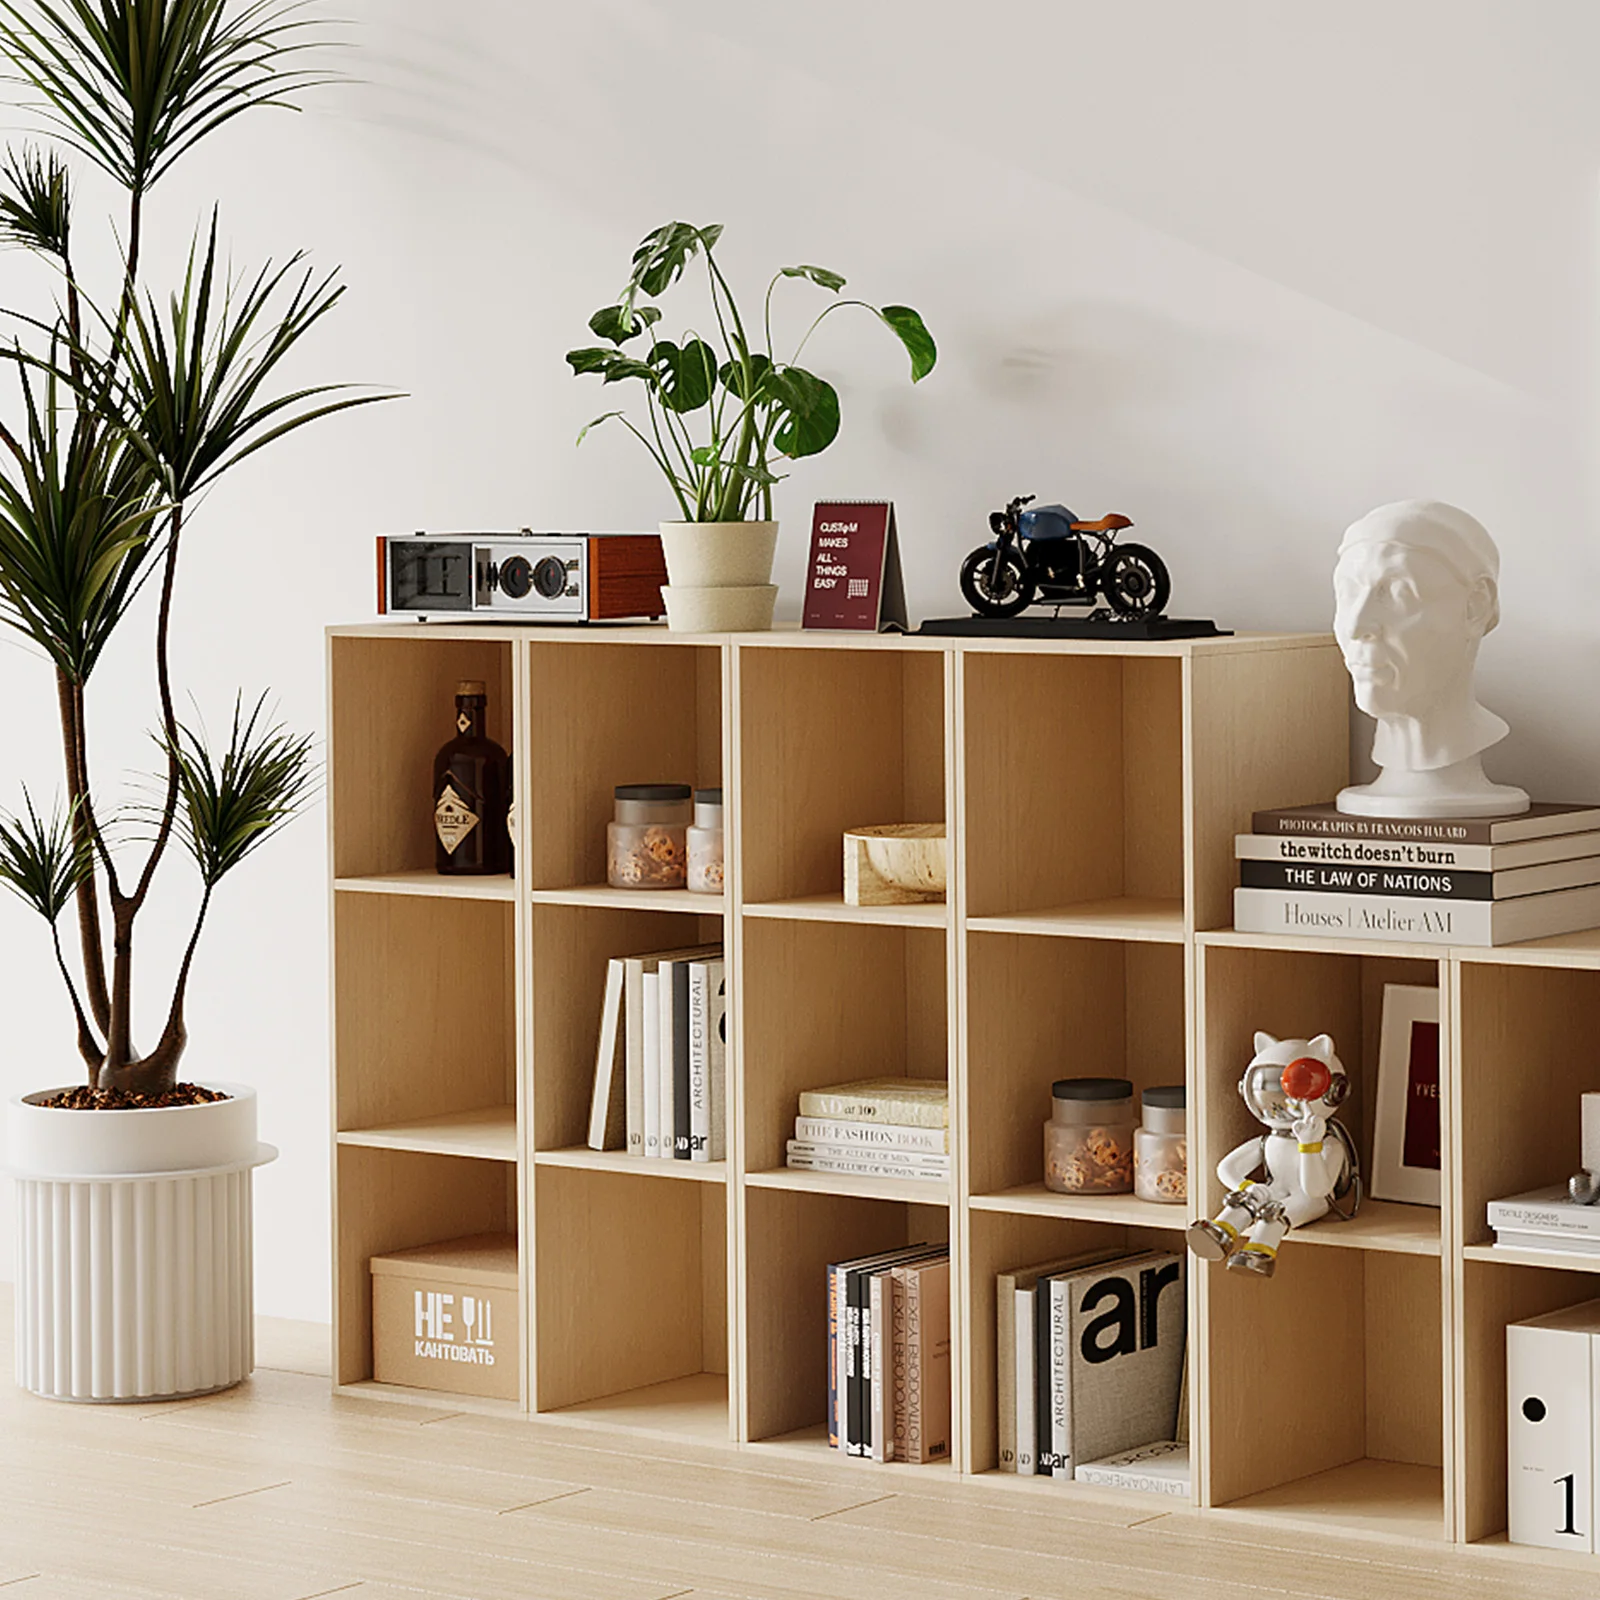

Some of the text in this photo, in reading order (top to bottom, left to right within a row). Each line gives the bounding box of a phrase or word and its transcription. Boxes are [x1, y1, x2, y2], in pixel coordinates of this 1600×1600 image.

[819, 537, 848, 548] MAKES
[816, 565, 847, 576] THINGS
[814, 578, 837, 589] EASY
[1279, 819, 1354, 832] PHOTOGRAPHS
[1357, 822, 1369, 833] BY
[1424, 826, 1467, 838] HALARD
[1281, 841, 1455, 864] the witch doesn't burn
[1285, 868, 1452, 892] THE LAW OF NATIONS
[1284, 903, 1452, 933] Houses Atelier AM
[692, 977, 703, 1109] ARCHITECTURAL
[1415, 1082, 1440, 1099] YVE
[690, 1135, 707, 1150] ar
[802, 1124, 933, 1148] THE FASHION BOOK
[1079, 1261, 1180, 1364] ar
[414, 1340, 495, 1365] КАНТОВАТЬ
[1053, 1294, 1064, 1427] ARCHITECTURAL
[1052, 1453, 1070, 1468] ar
[1084, 1471, 1184, 1495] LATINOAMERICA
[1553, 1473, 1584, 1536] 1
